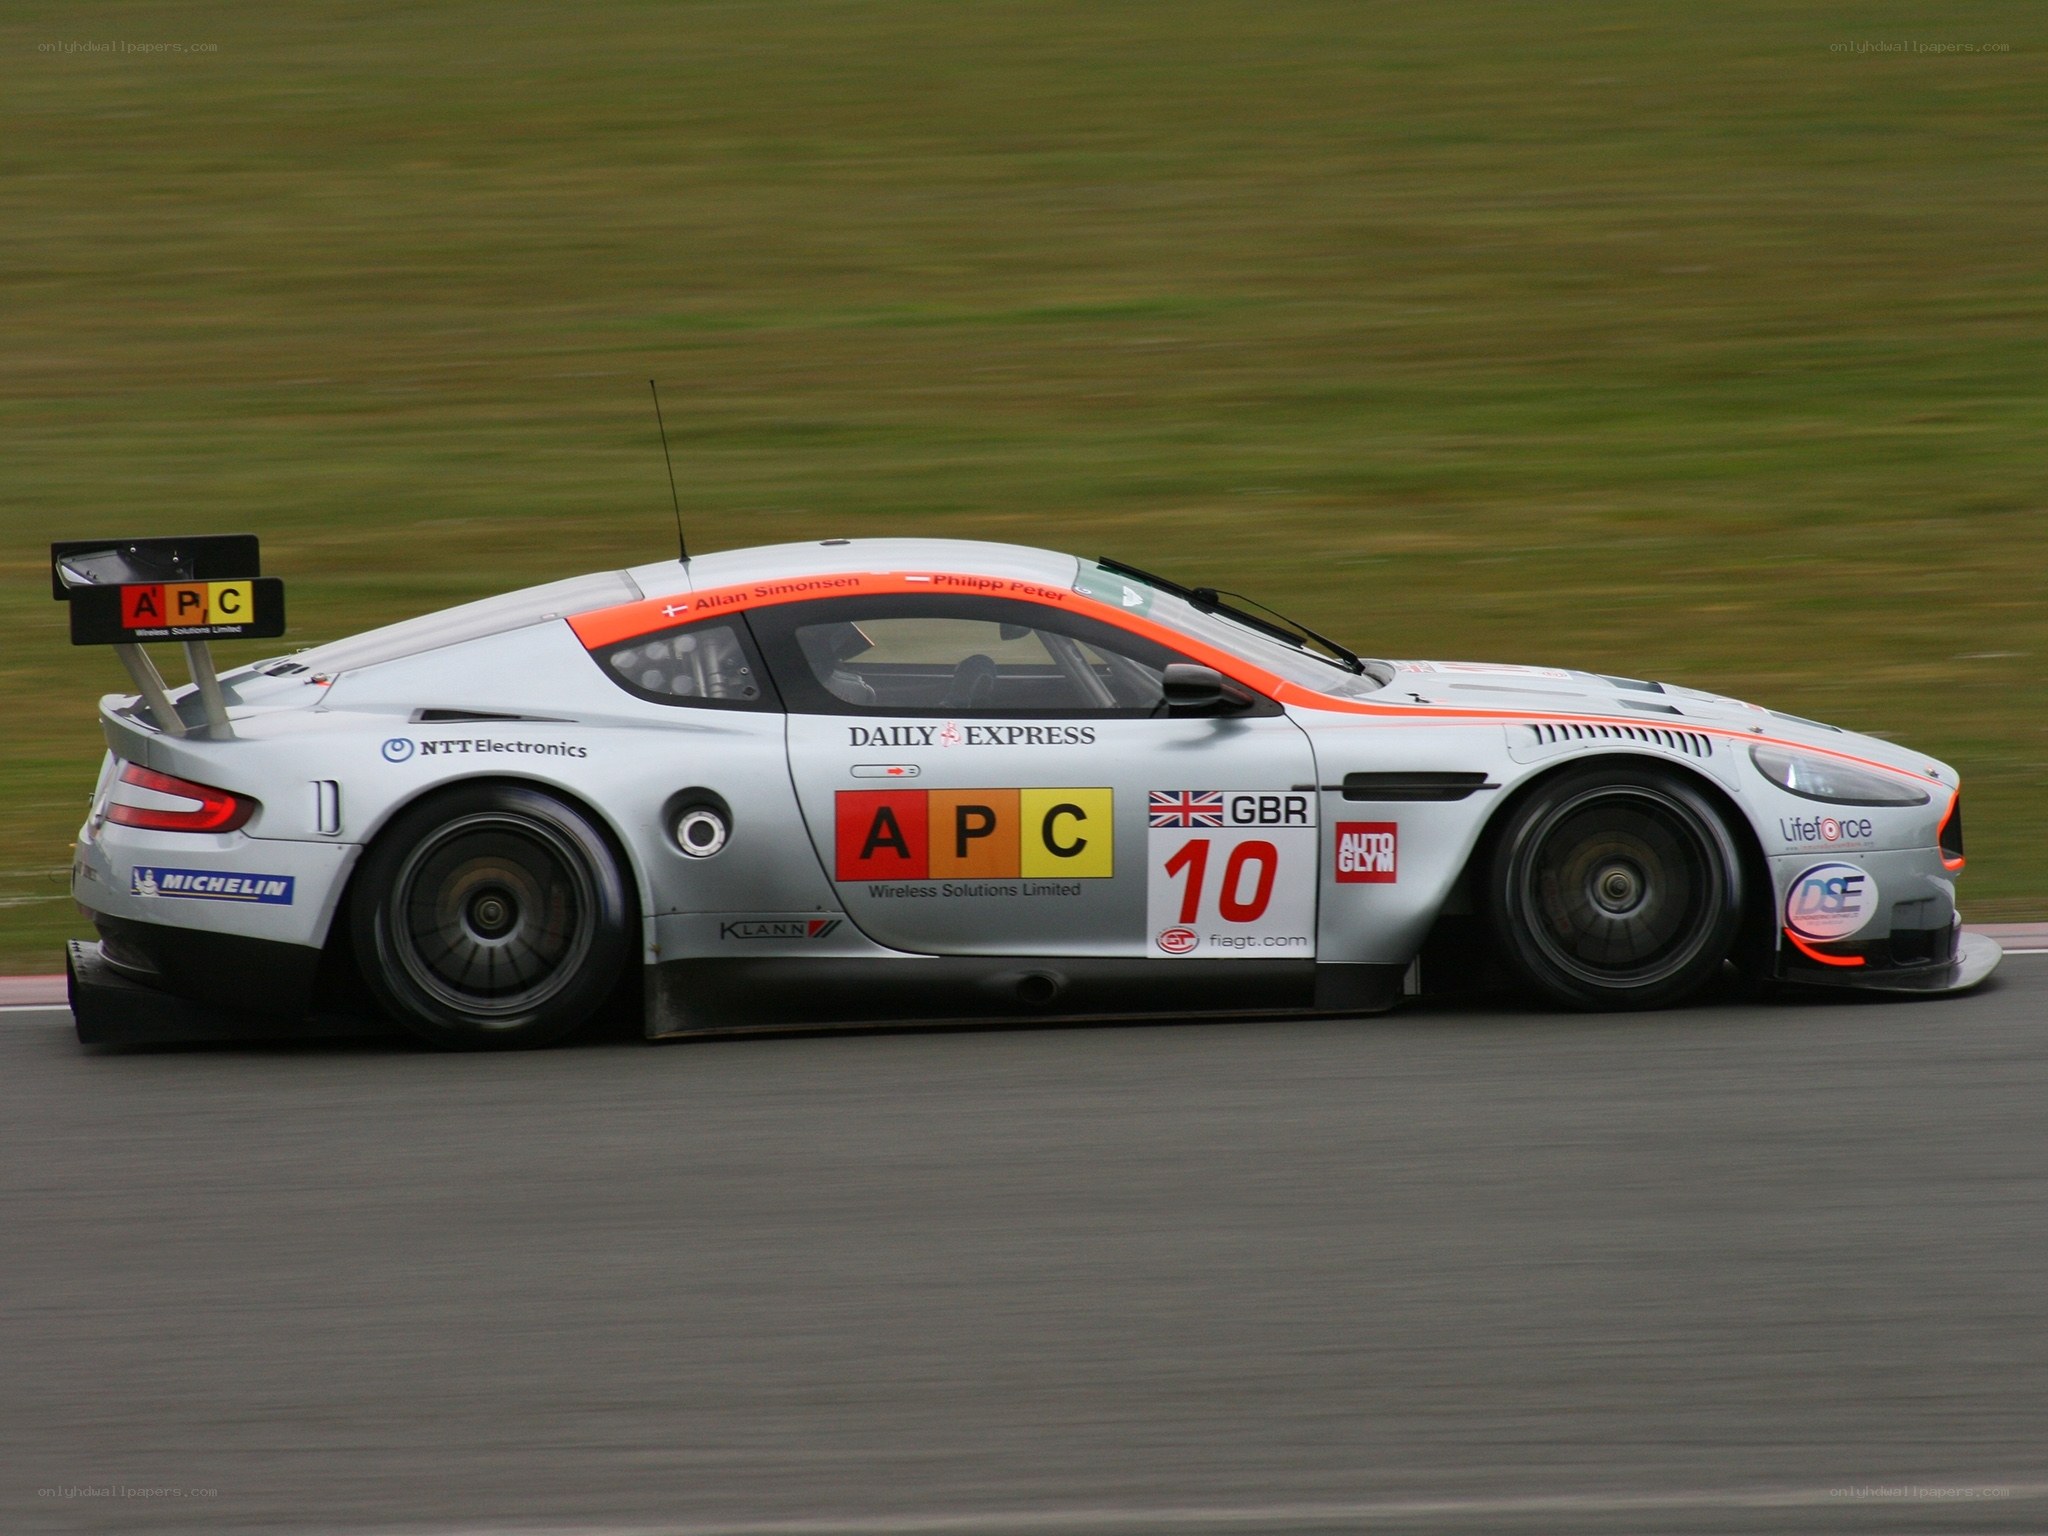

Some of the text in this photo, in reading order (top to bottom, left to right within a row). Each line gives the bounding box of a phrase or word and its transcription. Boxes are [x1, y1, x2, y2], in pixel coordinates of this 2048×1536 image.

[695, 576, 860, 611] Allan Simonsen
[933, 573, 1003, 591] Philipp
[1011, 580, 1067, 601] Peter
[171, 626, 211, 635] Solutions
[212, 625, 242, 634] Limited
[848, 726, 1095, 747] DAILY EXPRESS
[1231, 795, 1307, 824] GBR
[860, 803, 1088, 859] APC
[1779, 816, 1872, 842] Lifeforce
[1338, 833, 1394, 853] AUTO
[1338, 851, 1394, 872] GLYM
[161, 873, 288, 897] MICHELIN
[869, 882, 1081, 898] Wireless Solutions Limited
[1164, 838, 1278, 924] 10
[1795, 875, 1865, 914] DSE
[720, 921, 805, 940] KLANN
[1209, 934, 1307, 949] fiagt.com
